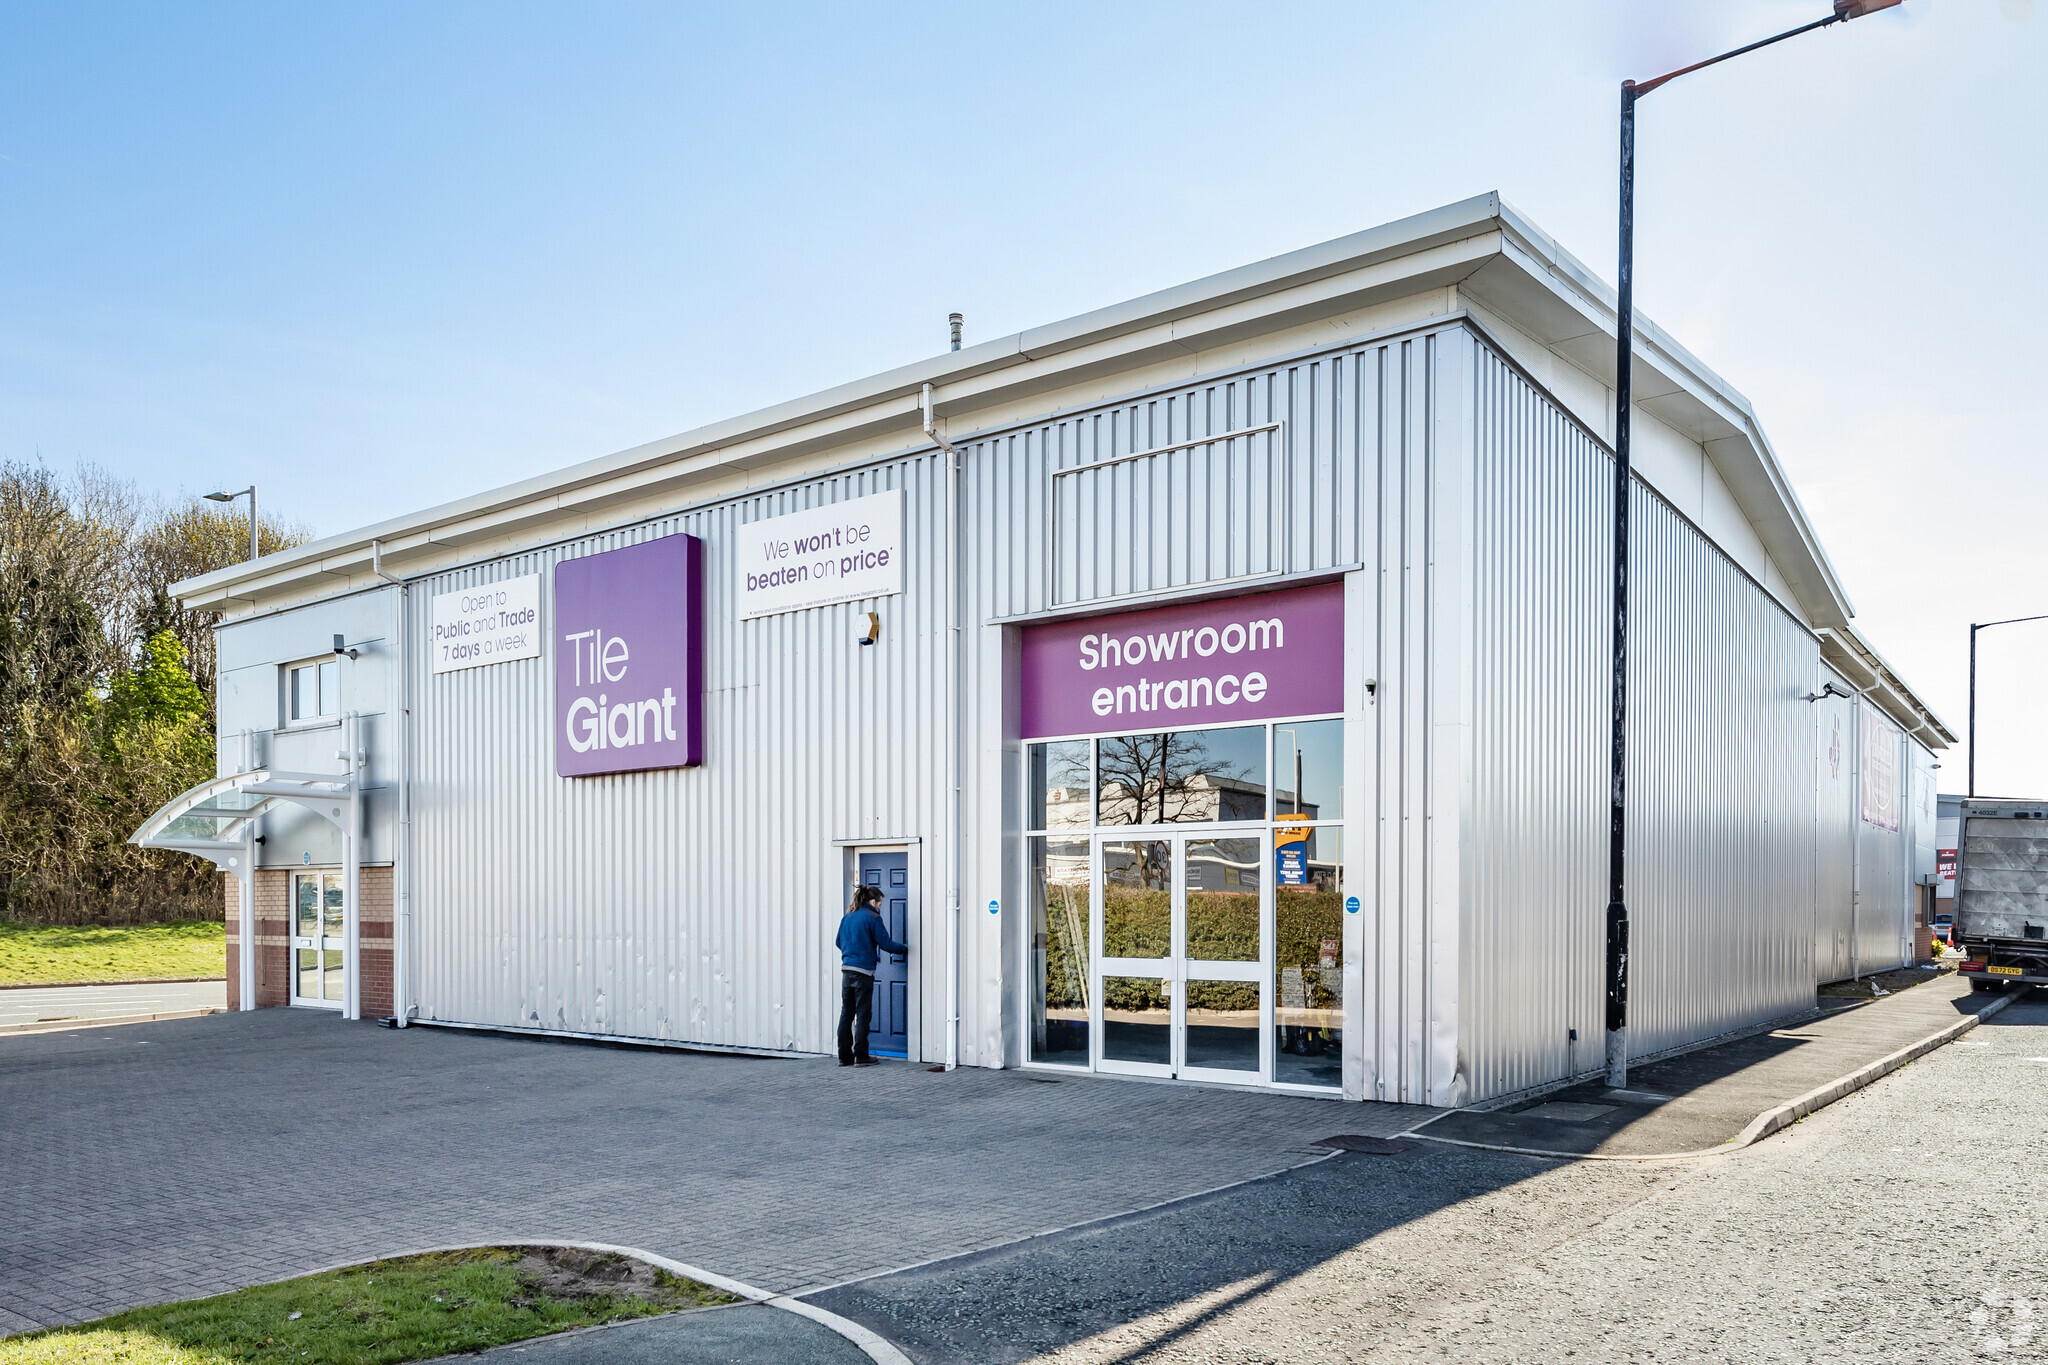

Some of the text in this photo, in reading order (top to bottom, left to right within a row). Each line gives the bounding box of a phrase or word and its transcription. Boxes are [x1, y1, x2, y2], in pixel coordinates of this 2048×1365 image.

[763, 524, 871, 561] We won't be
[747, 565, 808, 592] beaten
[813, 559, 835, 579] on
[461, 591, 507, 615] Open to
[436, 606, 535, 641] Public and Trade
[443, 631, 528, 661] 7 days a week
[565, 628, 629, 687] Tile
[1079, 617, 1284, 671] Showroom
[1091, 671, 1268, 717] entrance
[566, 687, 677, 753] Giant
[1939, 863, 1953, 871] WE
